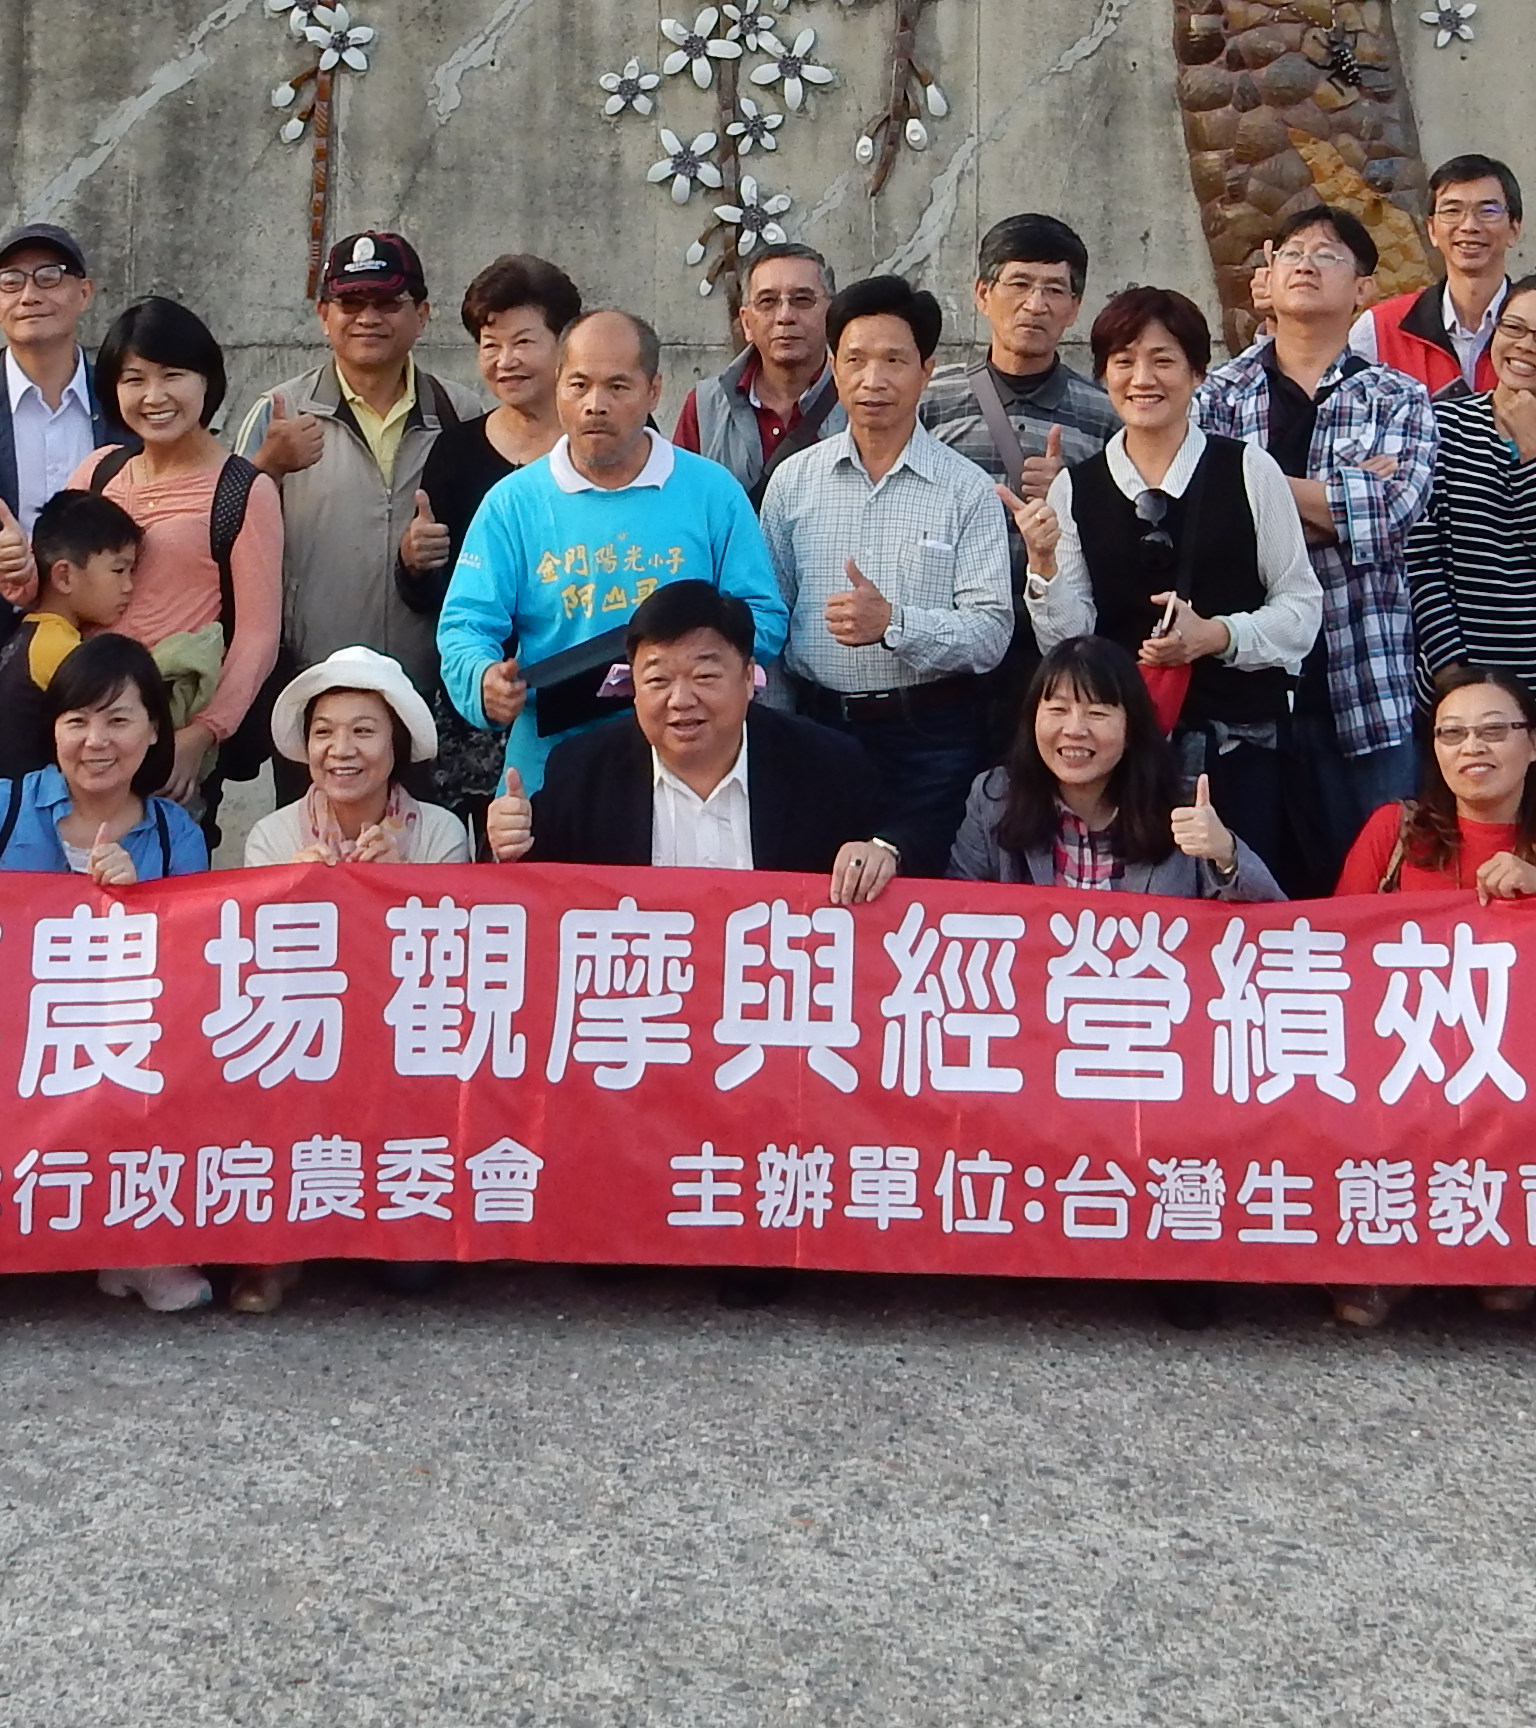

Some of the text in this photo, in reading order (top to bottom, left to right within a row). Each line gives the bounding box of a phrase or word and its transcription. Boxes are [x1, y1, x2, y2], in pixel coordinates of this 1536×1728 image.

[536, 543, 685, 584] 金門陽光小子
